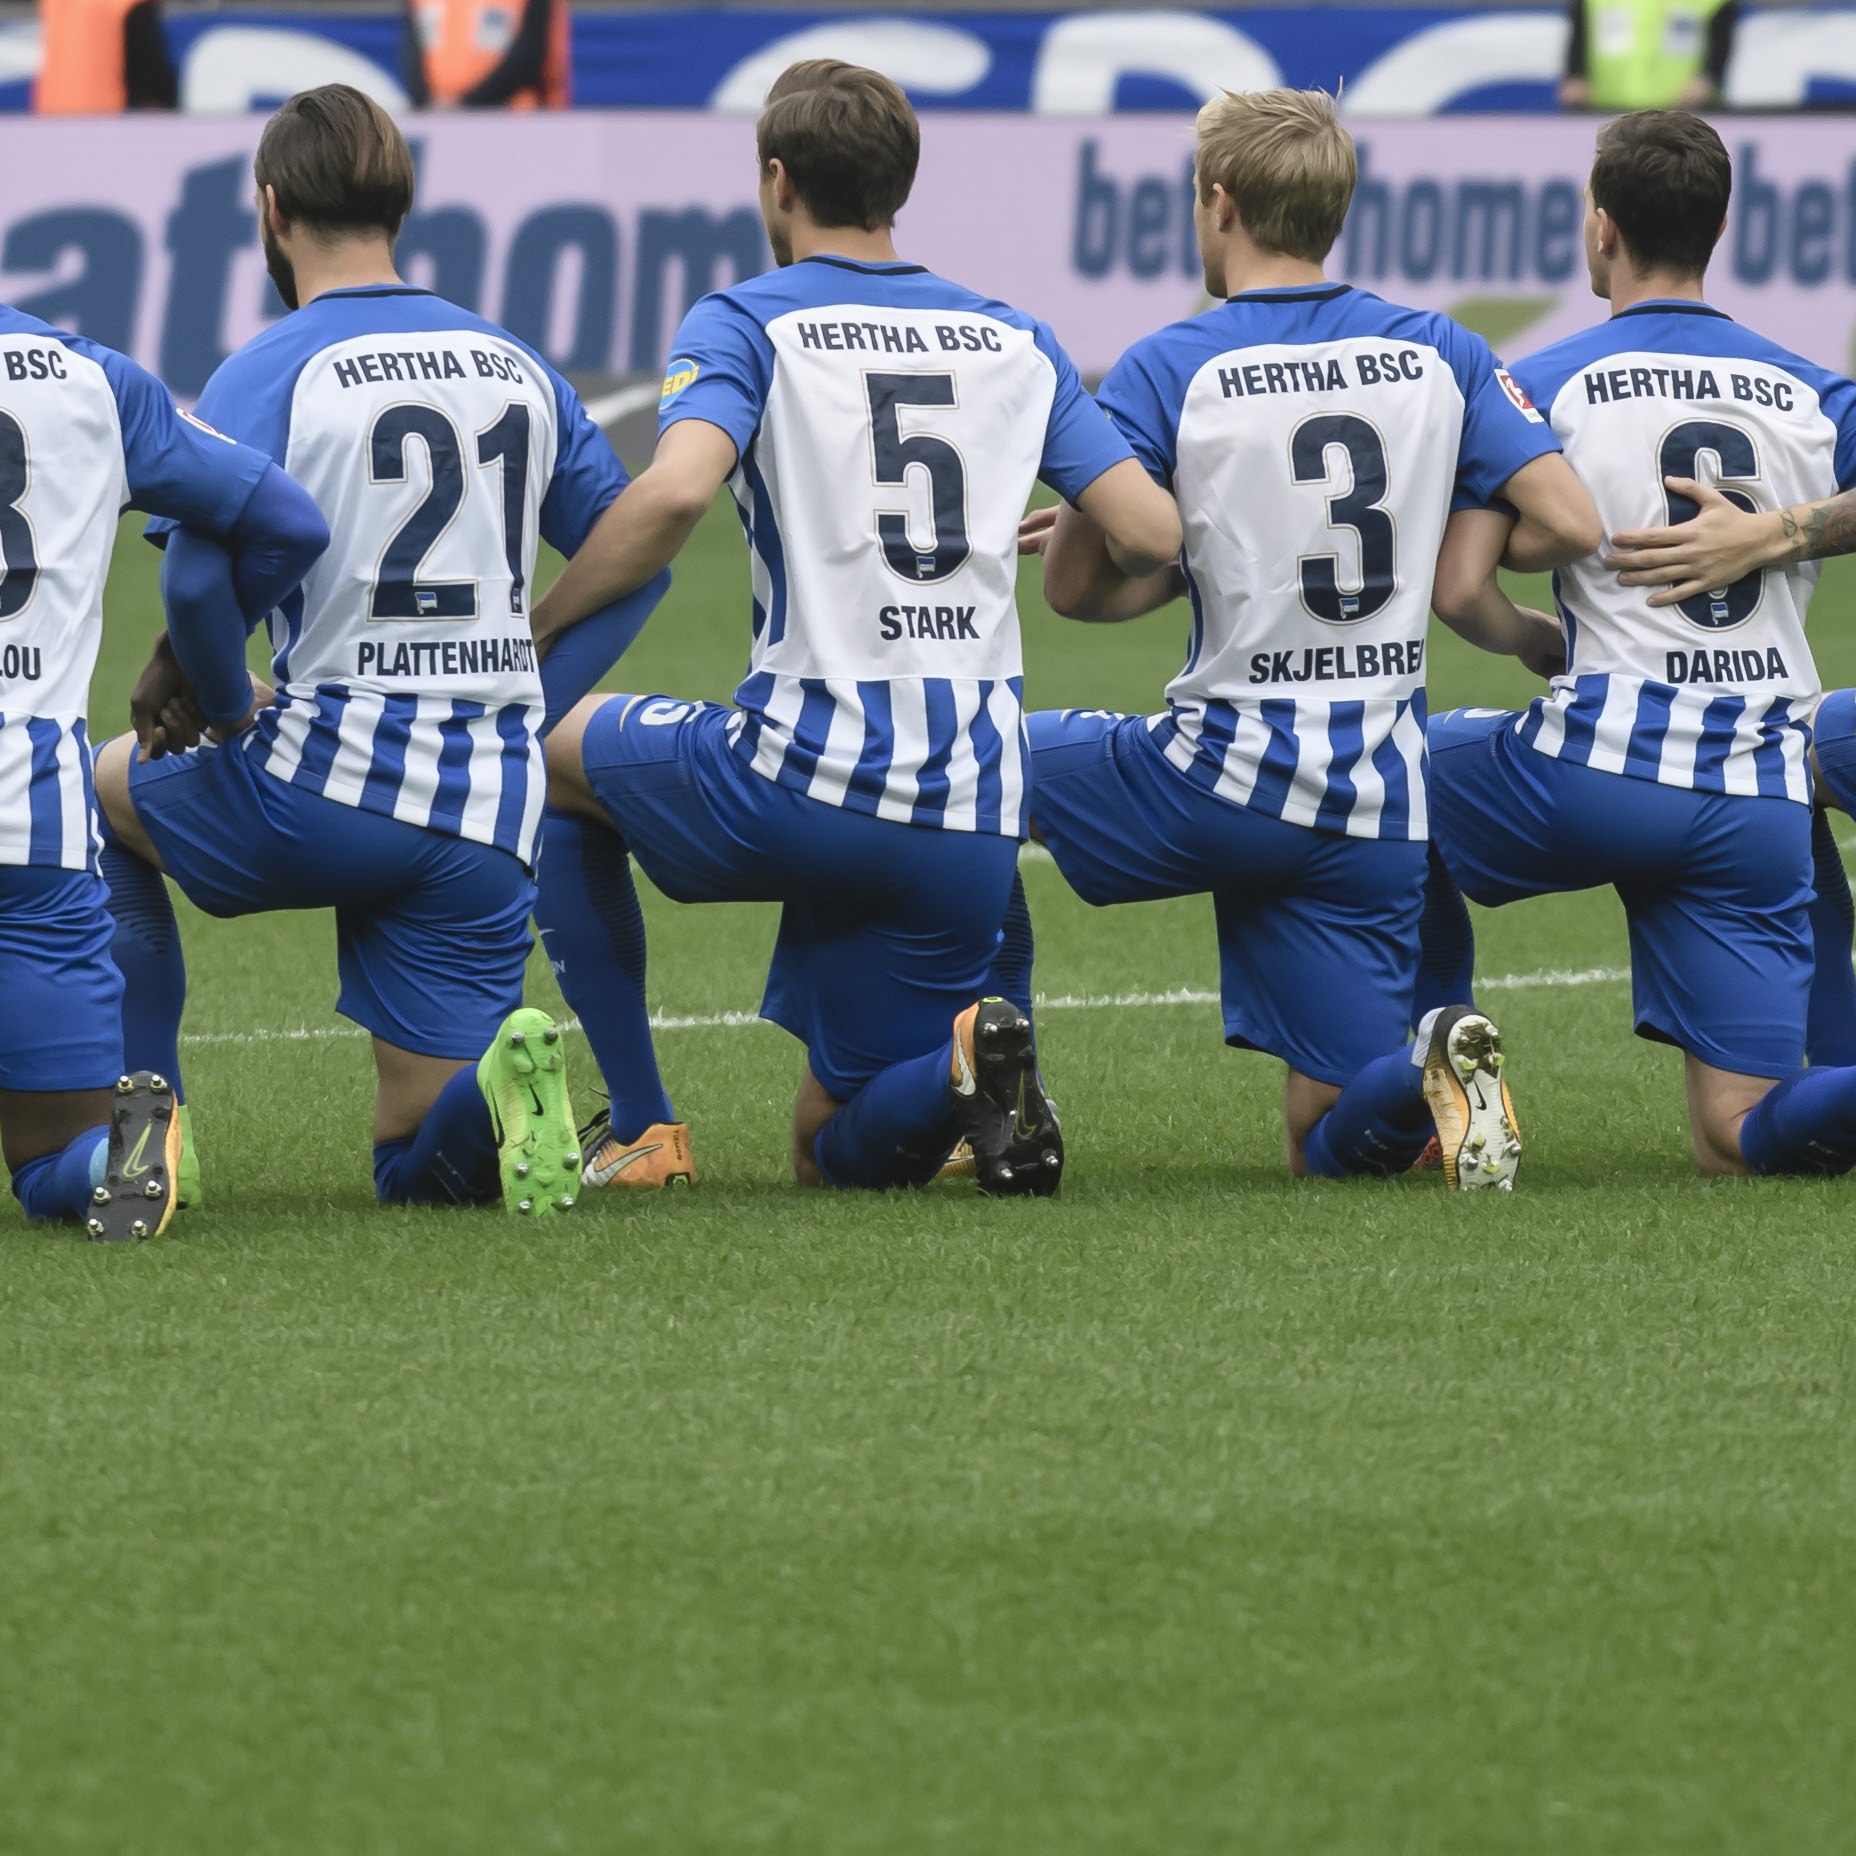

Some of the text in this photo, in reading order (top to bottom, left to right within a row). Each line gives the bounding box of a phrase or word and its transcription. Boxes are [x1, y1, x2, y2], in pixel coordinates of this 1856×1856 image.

[797, 322, 1002, 353] HERTHA BSC
[7, 349, 68, 381] BSC
[333, 350, 525, 388] HERTHA BSC
[1218, 349, 1424, 398] HERTHA BSC
[1584, 367, 1795, 412] HERTHA BSC
[859, 368, 974, 586] 5
[366, 398, 535, 623] 21
[1287, 409, 1400, 626] 3
[879, 605, 981, 640] STARK
[357, 638, 535, 676] PLATTENHARDT
[1249, 638, 1425, 684] SKJELBRE
[1666, 646, 1789, 684] DARIDA
